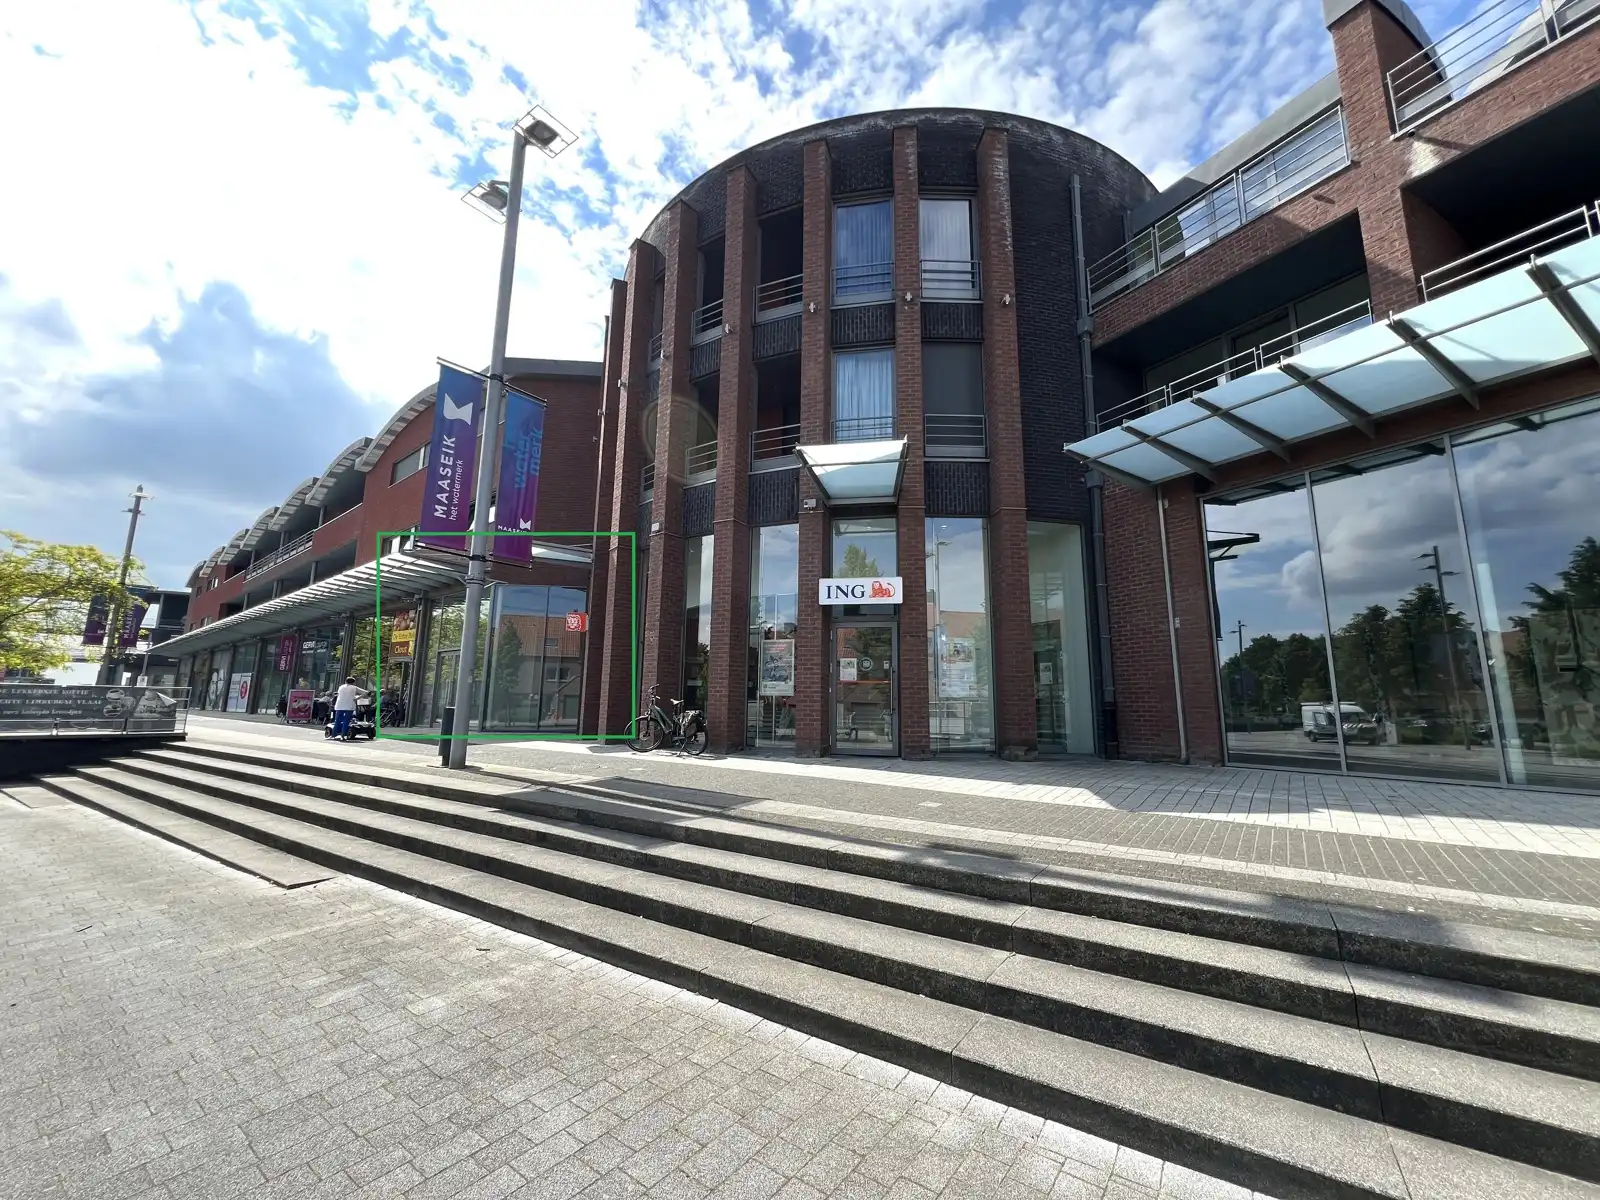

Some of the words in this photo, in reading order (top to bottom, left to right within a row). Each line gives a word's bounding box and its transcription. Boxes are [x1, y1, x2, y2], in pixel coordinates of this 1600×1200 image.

[530, 426, 543, 477] merk
[433, 434, 456, 519] MAASEIK
[451, 459, 464, 505] watermerk
[448, 506, 459, 521] het
[825, 584, 866, 600] ING
